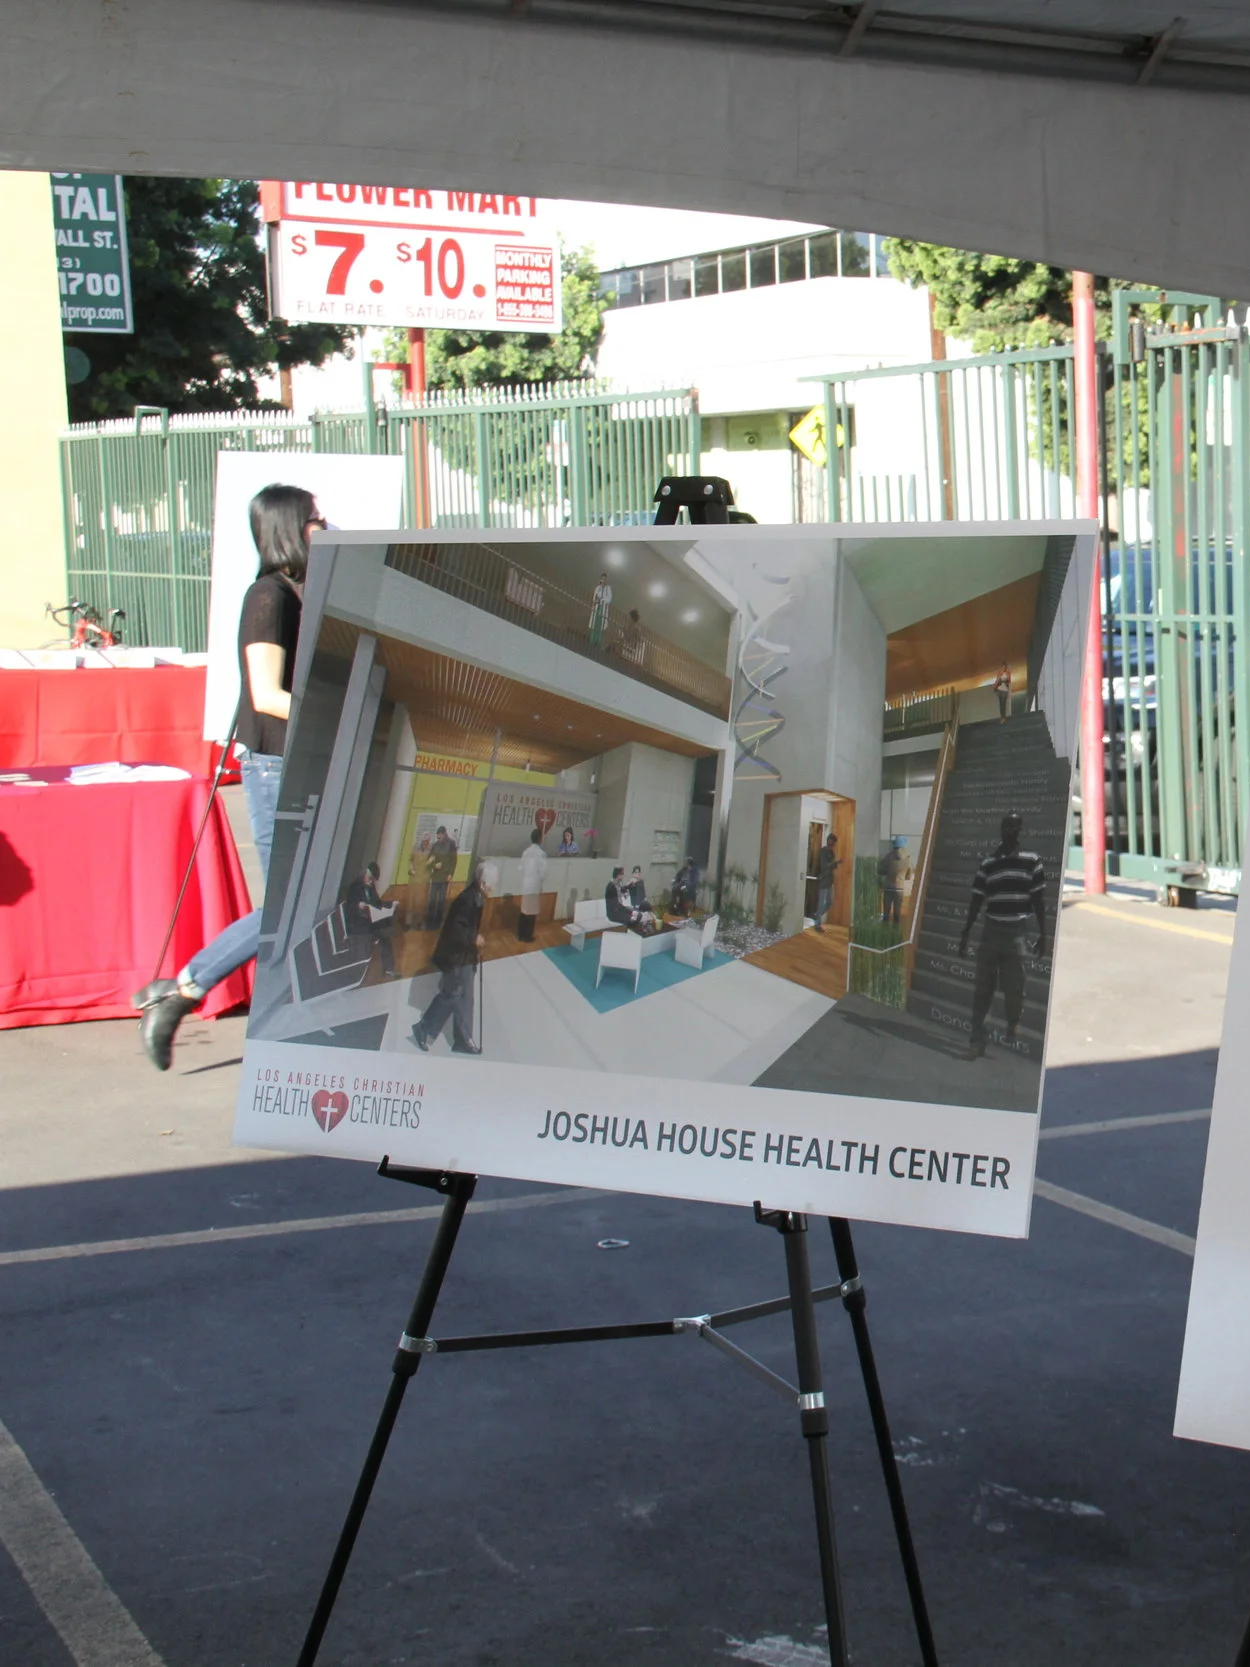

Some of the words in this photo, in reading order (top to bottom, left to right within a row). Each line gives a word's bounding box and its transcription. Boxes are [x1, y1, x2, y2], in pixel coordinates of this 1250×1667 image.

[54, 229, 90, 247] ALL
[93, 231, 118, 249] ST.
[496, 250, 552, 268] MONTHLY
[497, 268, 551, 285] PARKING
[497, 286, 552, 302] AVAILABLE
[60, 301, 124, 325] lprop.com
[297, 300, 336, 315] FLAT
[345, 302, 386, 317] RATE
[406, 305, 485, 322] SATURDAY
[415, 754, 478, 776] PHARMACY
[497, 792, 514, 804] LOS
[493, 804, 534, 826] HEALTH
[556, 809, 590, 828] CENTERS
[257, 1068, 280, 1082] LOS
[287, 1071, 345, 1089] ANGELES
[353, 1077, 425, 1097] CHRISTIAN
[252, 1084, 310, 1117] HEALTH
[350, 1094, 422, 1129] CENTERS
[537, 1109, 649, 1150] JOSHUA
[656, 1121, 756, 1162] HOUSE
[763, 1132, 880, 1176] HEALTH
[888, 1145, 1011, 1190] CENTER
